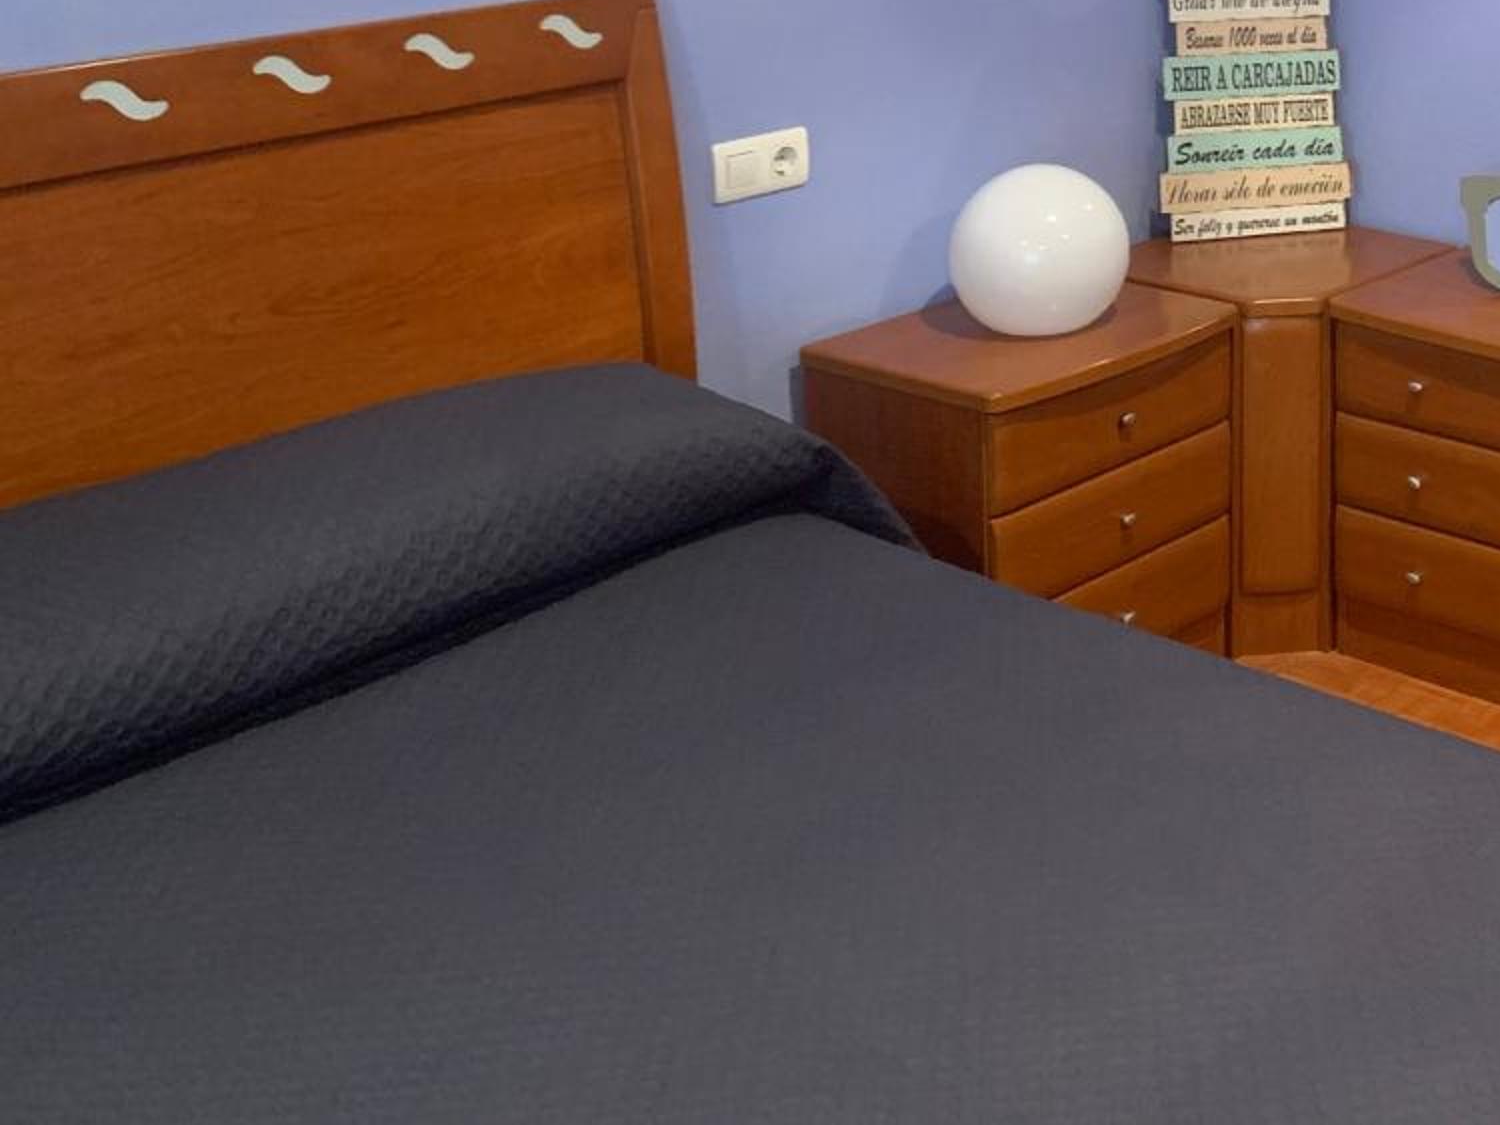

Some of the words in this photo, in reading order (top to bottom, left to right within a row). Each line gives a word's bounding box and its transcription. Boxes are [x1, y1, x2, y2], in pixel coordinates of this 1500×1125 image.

[1229, 26, 1257, 47] 1000
[1216, 64, 1227, 89] A
[1232, 59, 1337, 89] CARCAJADAS
[1181, 102, 1251, 129] ABRAZARSE
[1254, 101, 1280, 124] MUY
[1283, 99, 1329, 123] FUERTE
[1253, 139, 1296, 159] cada
[1256, 176, 1273, 198] de
